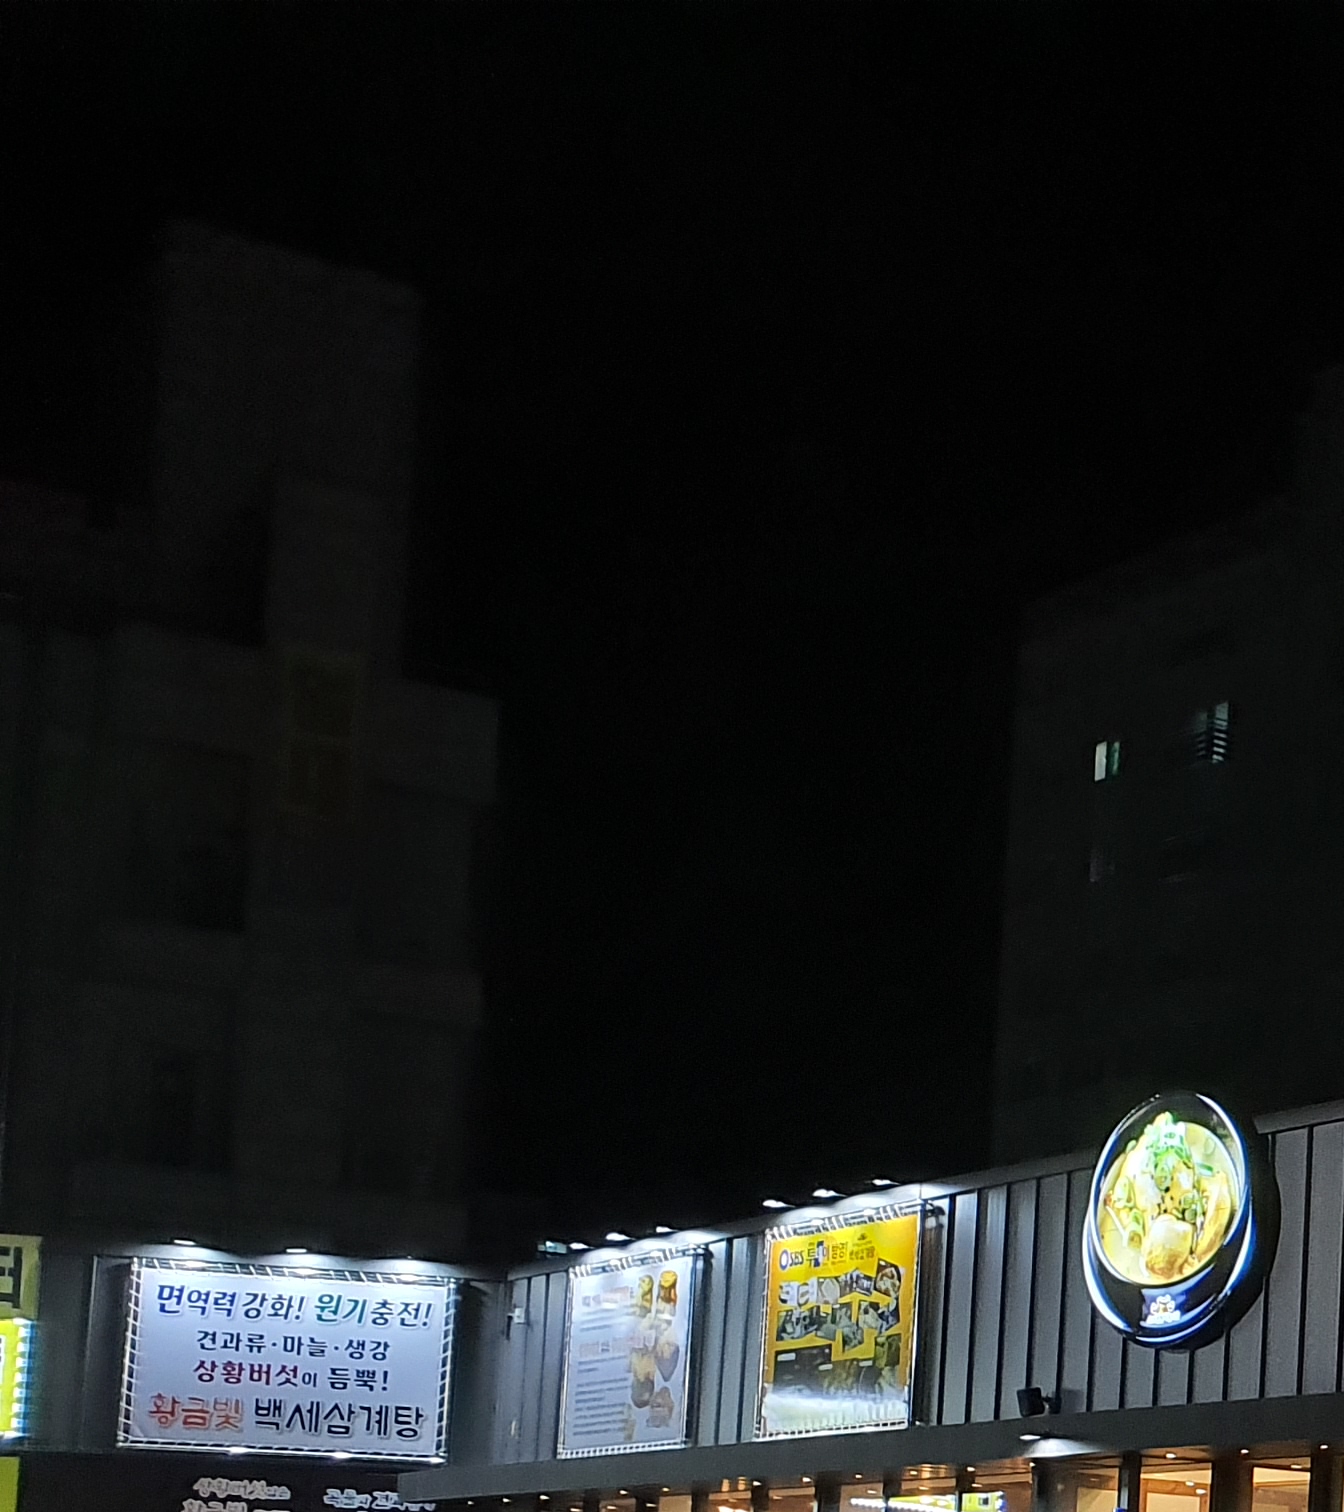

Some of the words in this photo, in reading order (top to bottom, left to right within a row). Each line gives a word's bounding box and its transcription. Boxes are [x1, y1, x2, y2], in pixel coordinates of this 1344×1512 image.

[194, 1360, 318, 1388] 상황버섯이
[327, 1367, 388, 1391] 듬뿍!
[148, 1392, 244, 1431] 황금빛
[254, 1397, 424, 1438] 백세삼계탕
